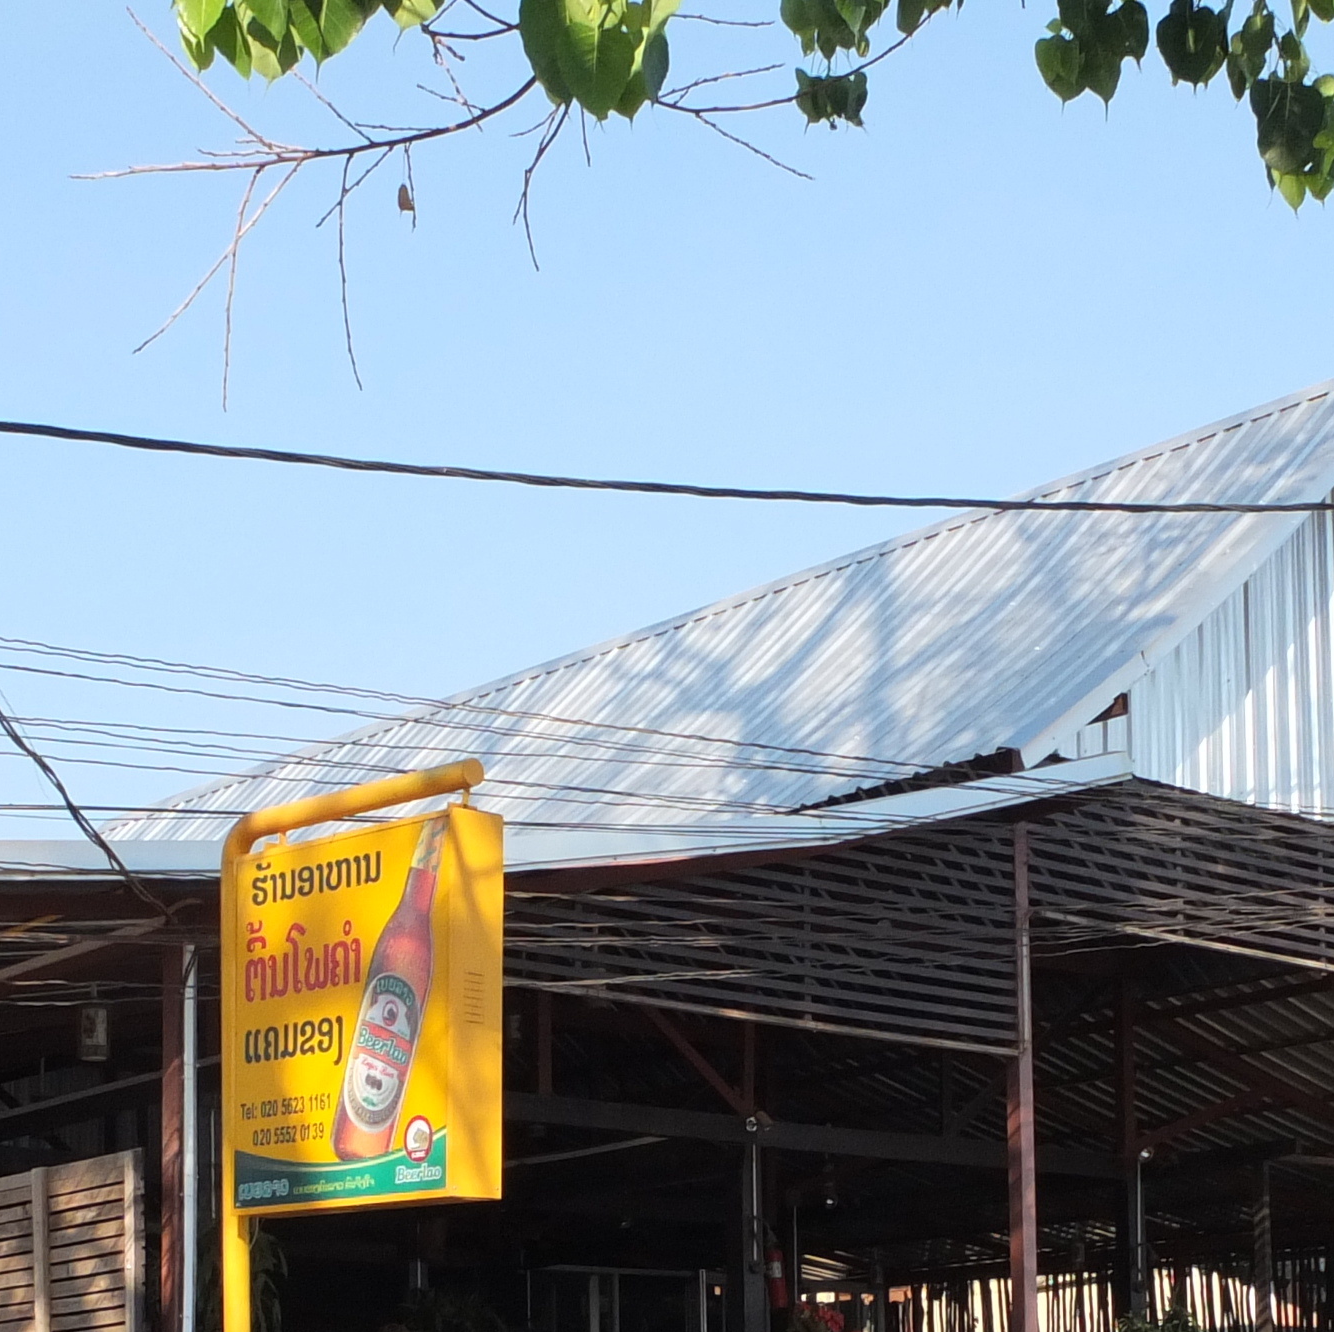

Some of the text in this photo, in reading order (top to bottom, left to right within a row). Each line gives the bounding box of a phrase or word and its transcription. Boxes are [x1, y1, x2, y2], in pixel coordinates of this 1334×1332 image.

[252, 851, 381, 906] ຮ້ານອາຫານ
[245, 1015, 343, 1065] ແຄມຂອງ
[357, 1025, 408, 1066] Beerlao
[240, 1093, 331, 1120] Tel: 020 5623 1161
[252, 1128, 271, 1146] 020
[299, 1122, 324, 1142] 0139
[394, 1162, 442, 1184] Beerlao
